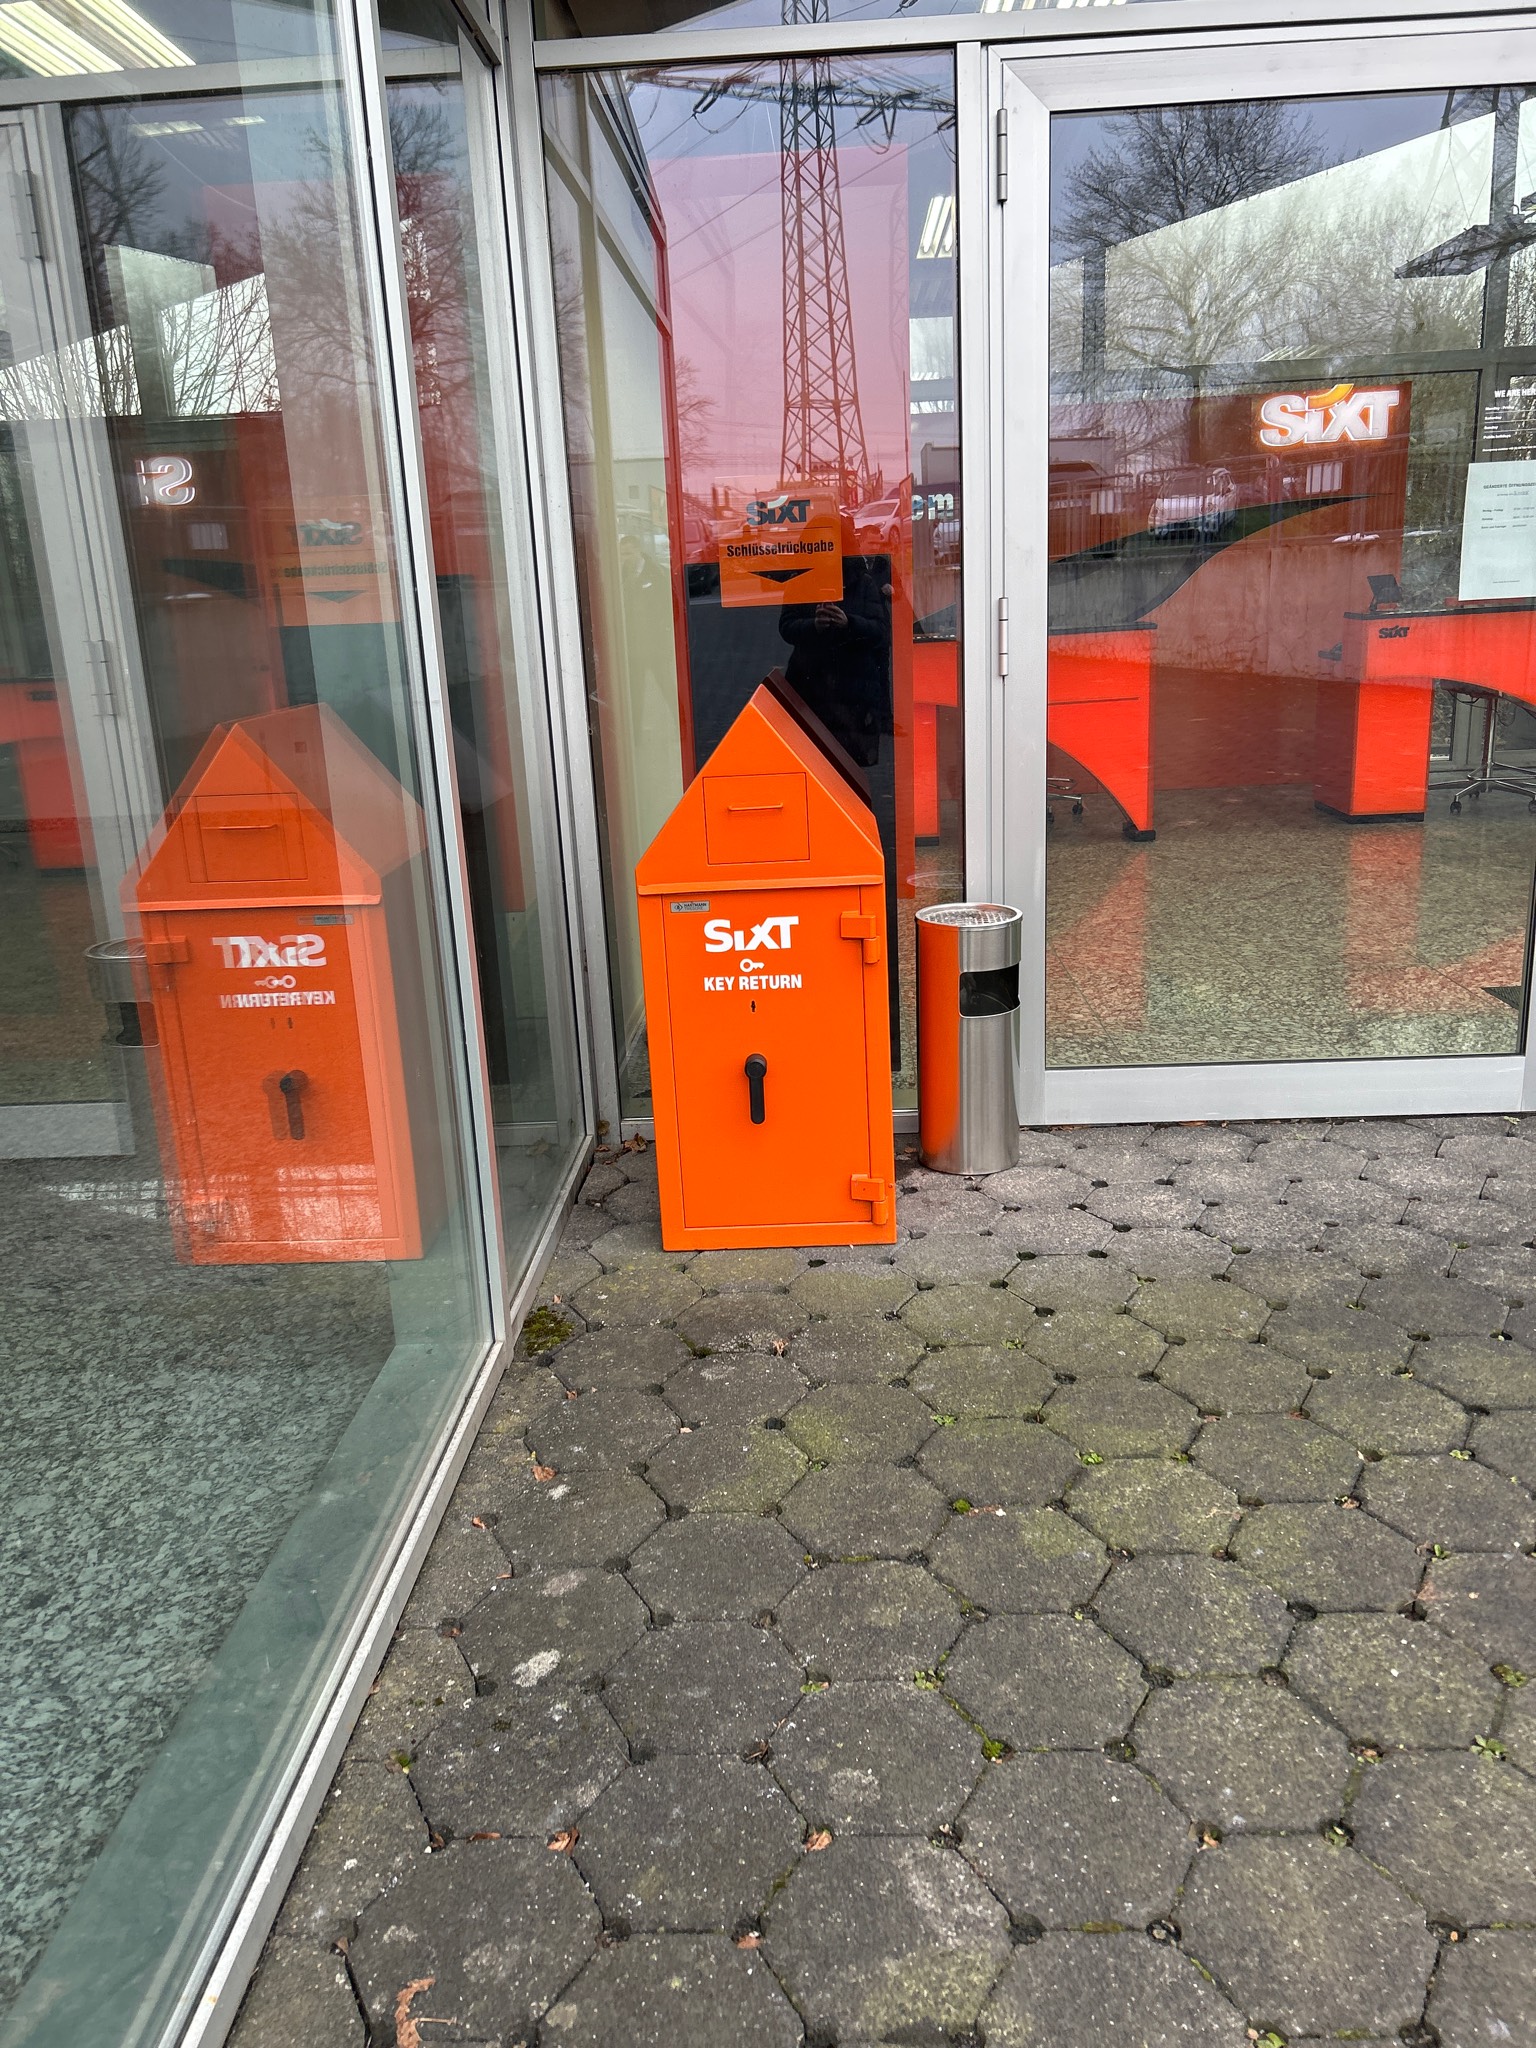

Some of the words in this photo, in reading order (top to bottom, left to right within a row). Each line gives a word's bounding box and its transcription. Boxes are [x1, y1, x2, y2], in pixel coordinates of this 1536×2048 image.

[1260, 383, 1400, 446] SIXT
[746, 495, 811, 526] SIXT
[727, 541, 834, 558] Schlüsselrückgabe
[703, 916, 799, 953] SIXT
[704, 976, 735, 991] KEY
[738, 974, 802, 990] RETURN
